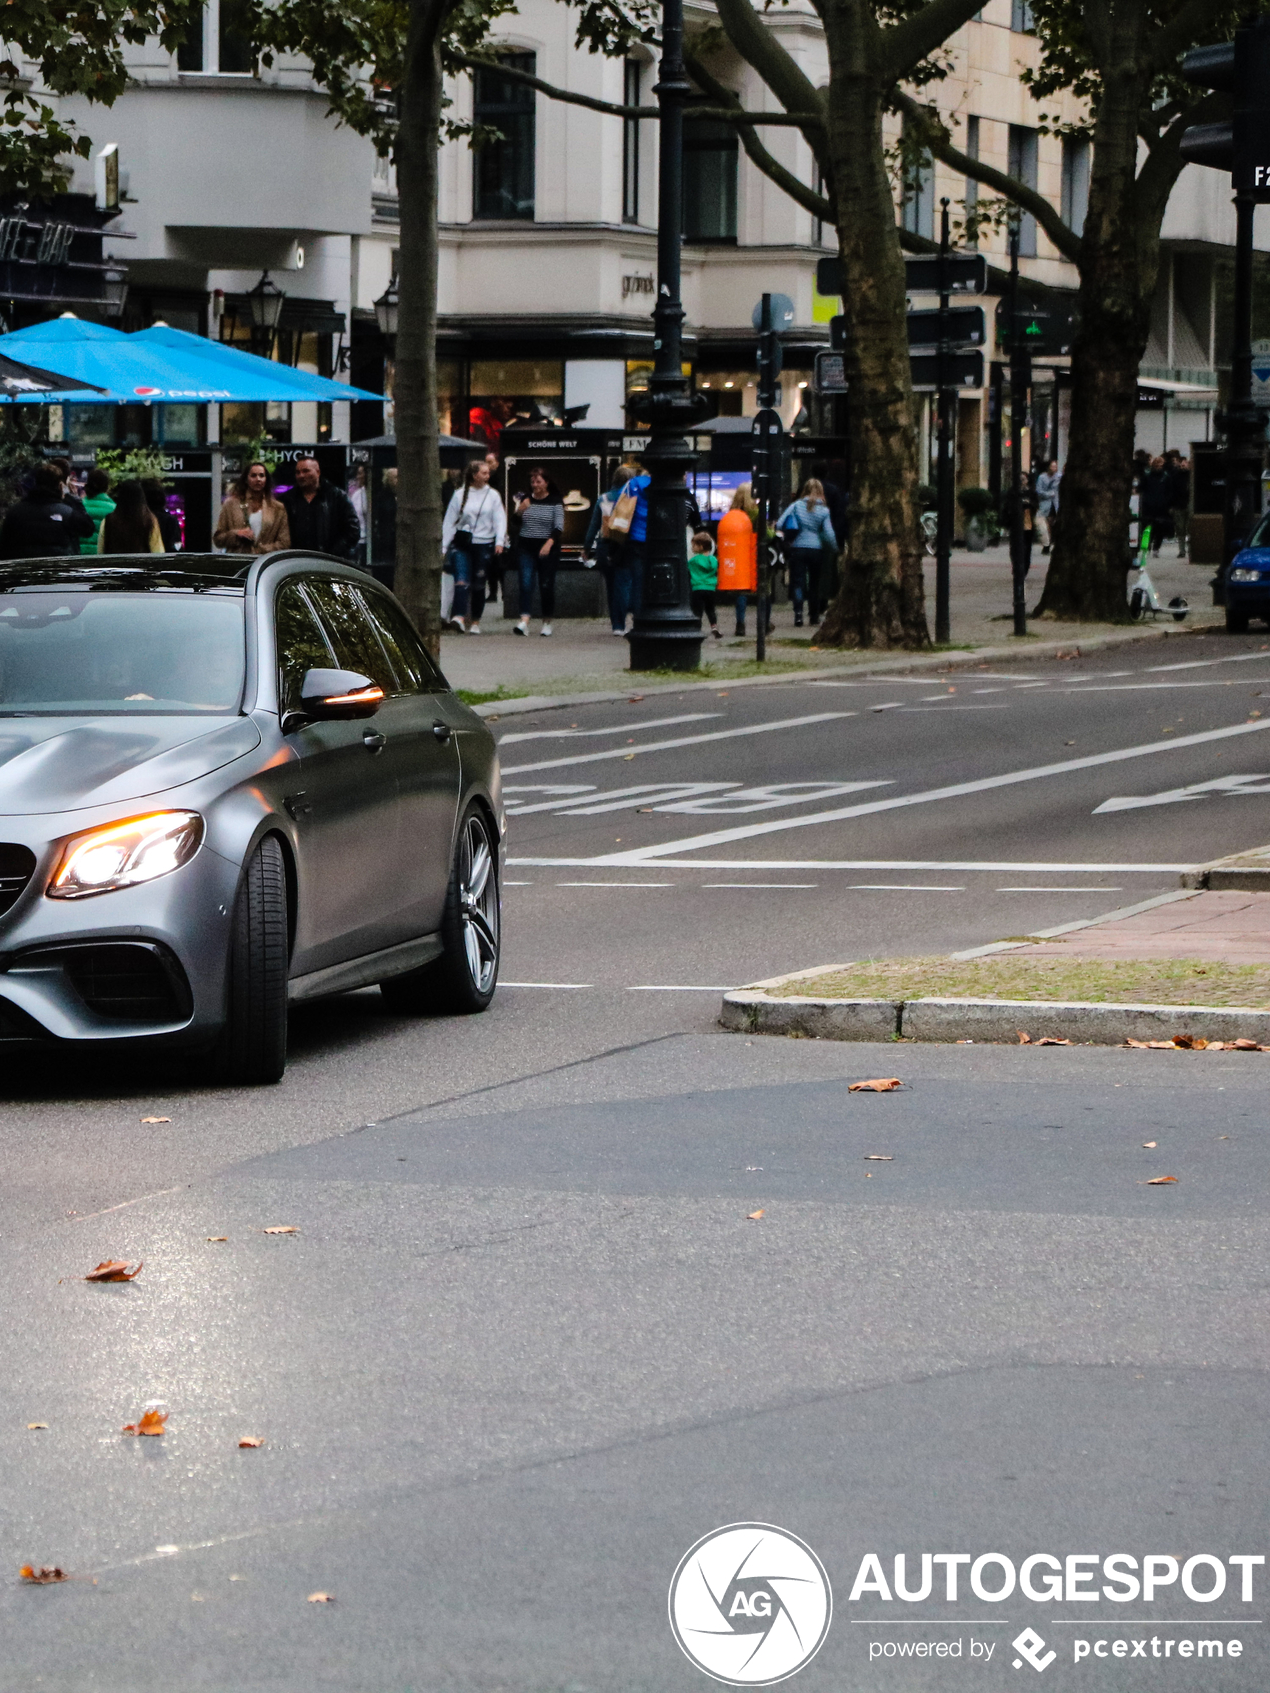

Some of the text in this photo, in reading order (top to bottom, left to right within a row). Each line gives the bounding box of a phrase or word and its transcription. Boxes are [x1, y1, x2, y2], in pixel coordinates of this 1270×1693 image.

[168, 389, 230, 398] pepsi
[528, 440, 577, 448] SCHÖNE WELT
